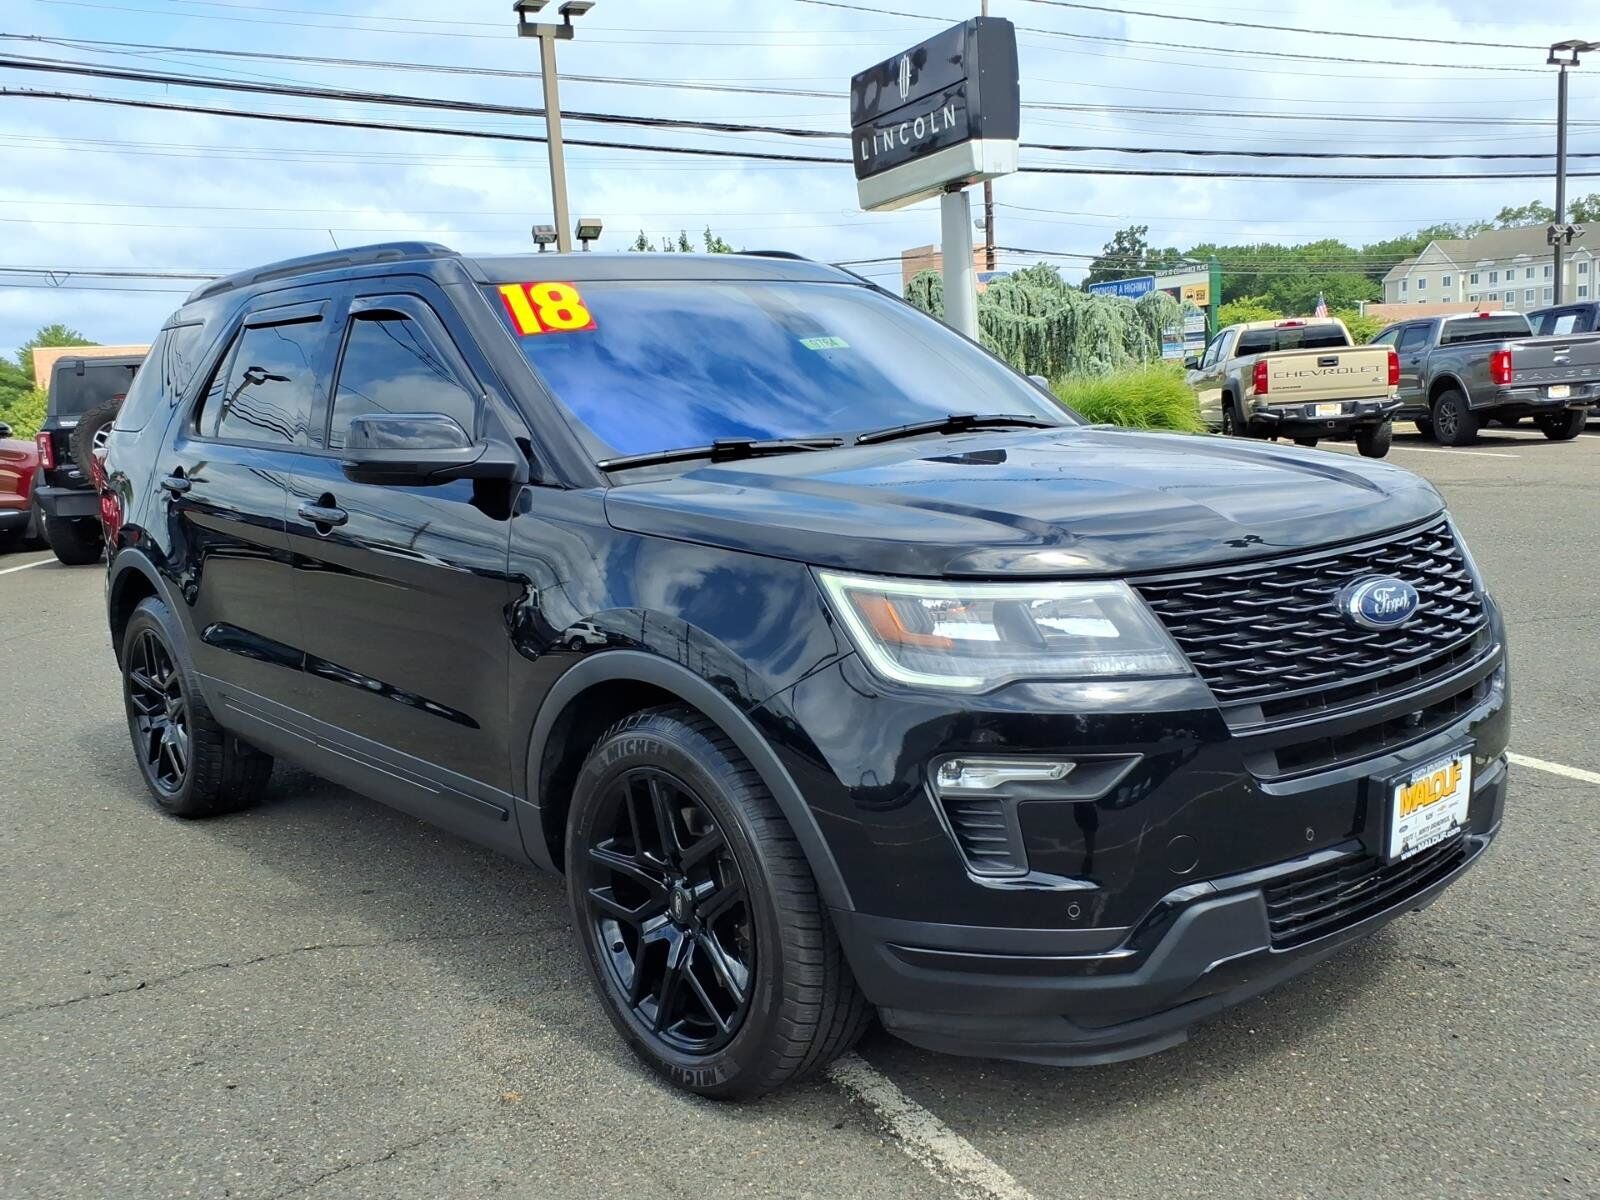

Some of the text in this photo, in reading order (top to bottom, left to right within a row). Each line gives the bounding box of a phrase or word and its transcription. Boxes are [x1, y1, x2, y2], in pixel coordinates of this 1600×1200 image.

[861, 104, 956, 161] LINCOLN
[499, 283, 591, 334] 18
[1274, 366, 1380, 379] CHEVROLET
[1374, 587, 1410, 617] Ford
[1400, 763, 1462, 818] MALOUF
